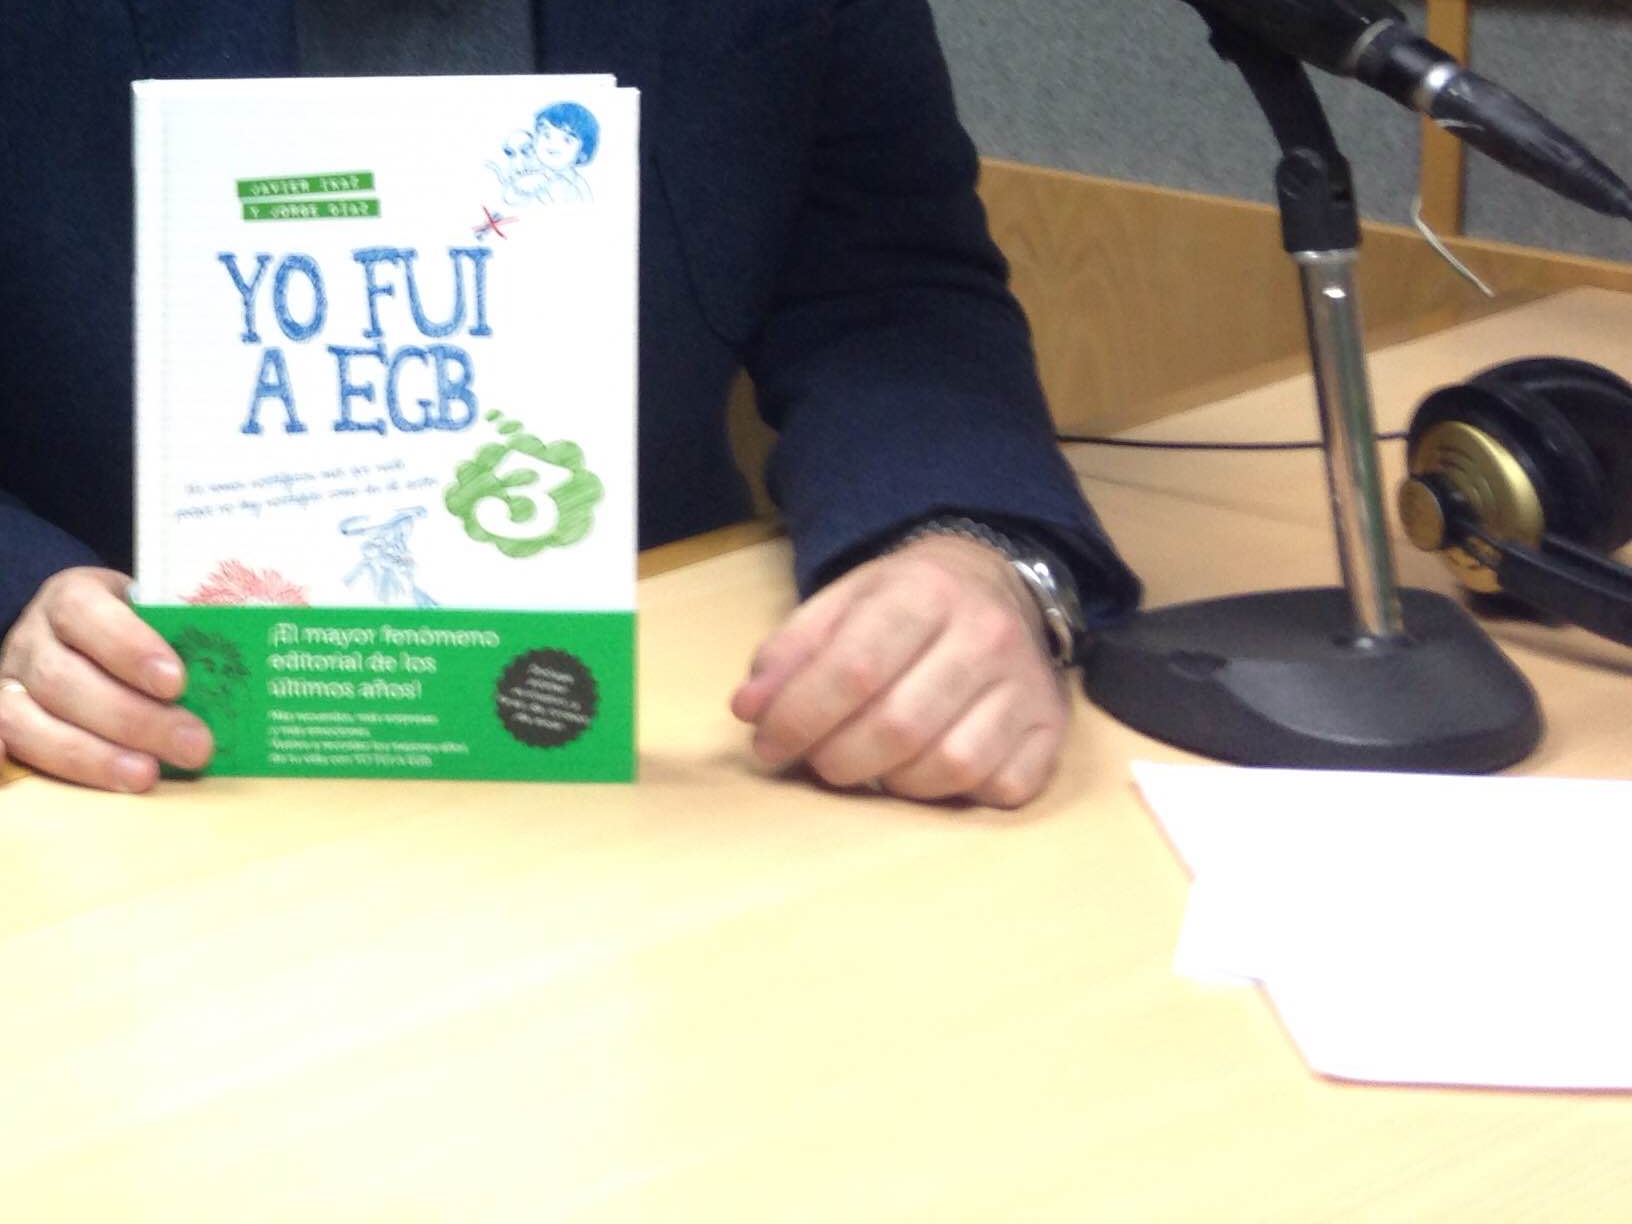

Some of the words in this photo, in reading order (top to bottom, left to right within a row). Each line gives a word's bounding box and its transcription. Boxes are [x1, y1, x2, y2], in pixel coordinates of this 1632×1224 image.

[216, 251, 328, 343] YO
[351, 246, 494, 339] FUI
[239, 346, 308, 434] A
[326, 341, 480, 436] EGB
[471, 447, 573, 541] 3
[267, 649, 363, 673] editorial
[364, 650, 398, 673] de
[399, 650, 438, 674] los
[301, 626, 376, 649] mayor
